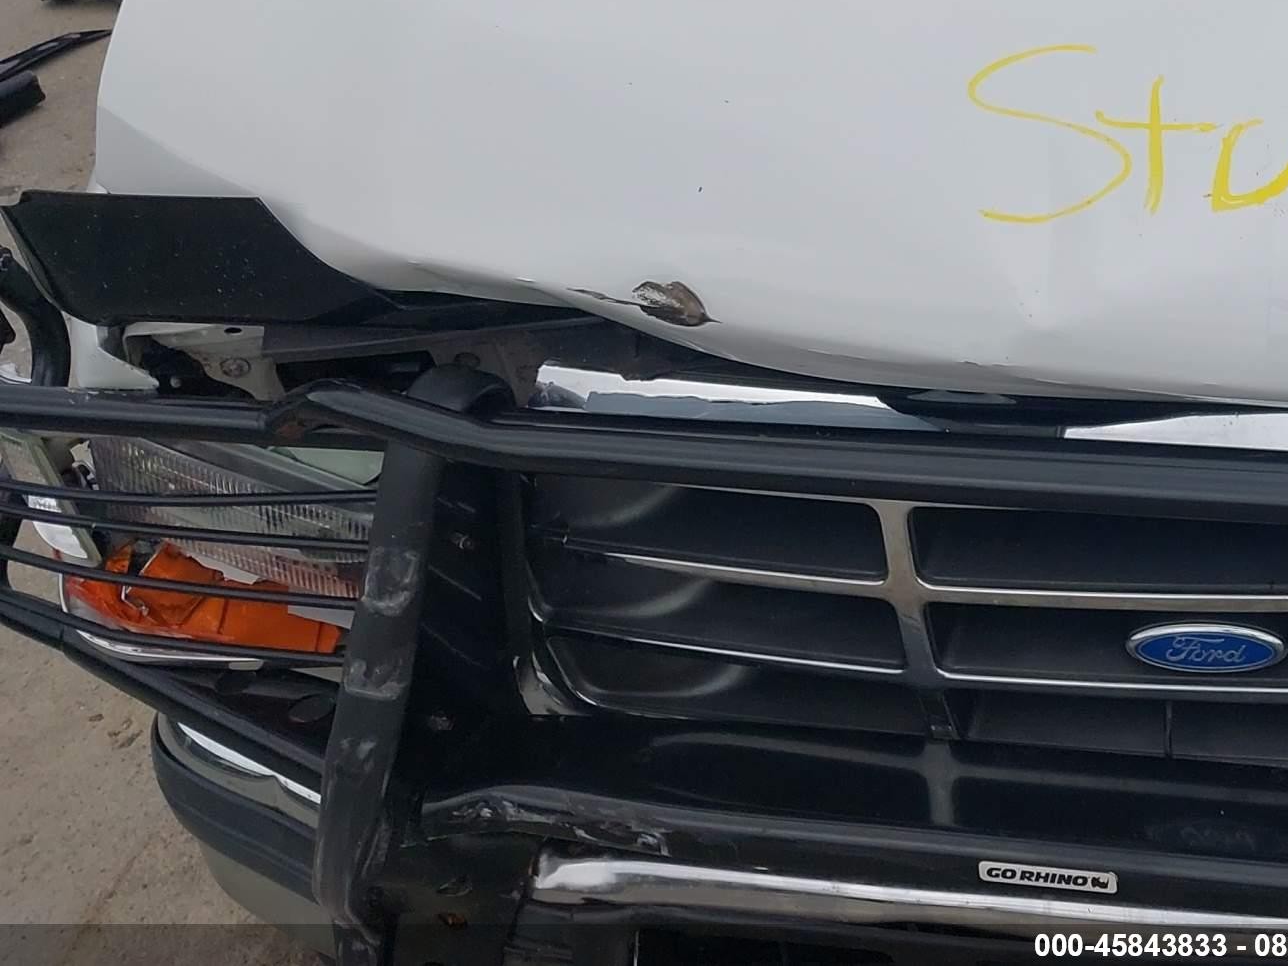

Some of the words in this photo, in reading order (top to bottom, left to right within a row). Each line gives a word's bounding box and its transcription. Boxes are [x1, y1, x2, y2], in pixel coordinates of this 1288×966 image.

[1165, 635, 1246, 663] Ford
[986, 866, 1017, 880] GO
[1019, 871, 1089, 887] RHINO
